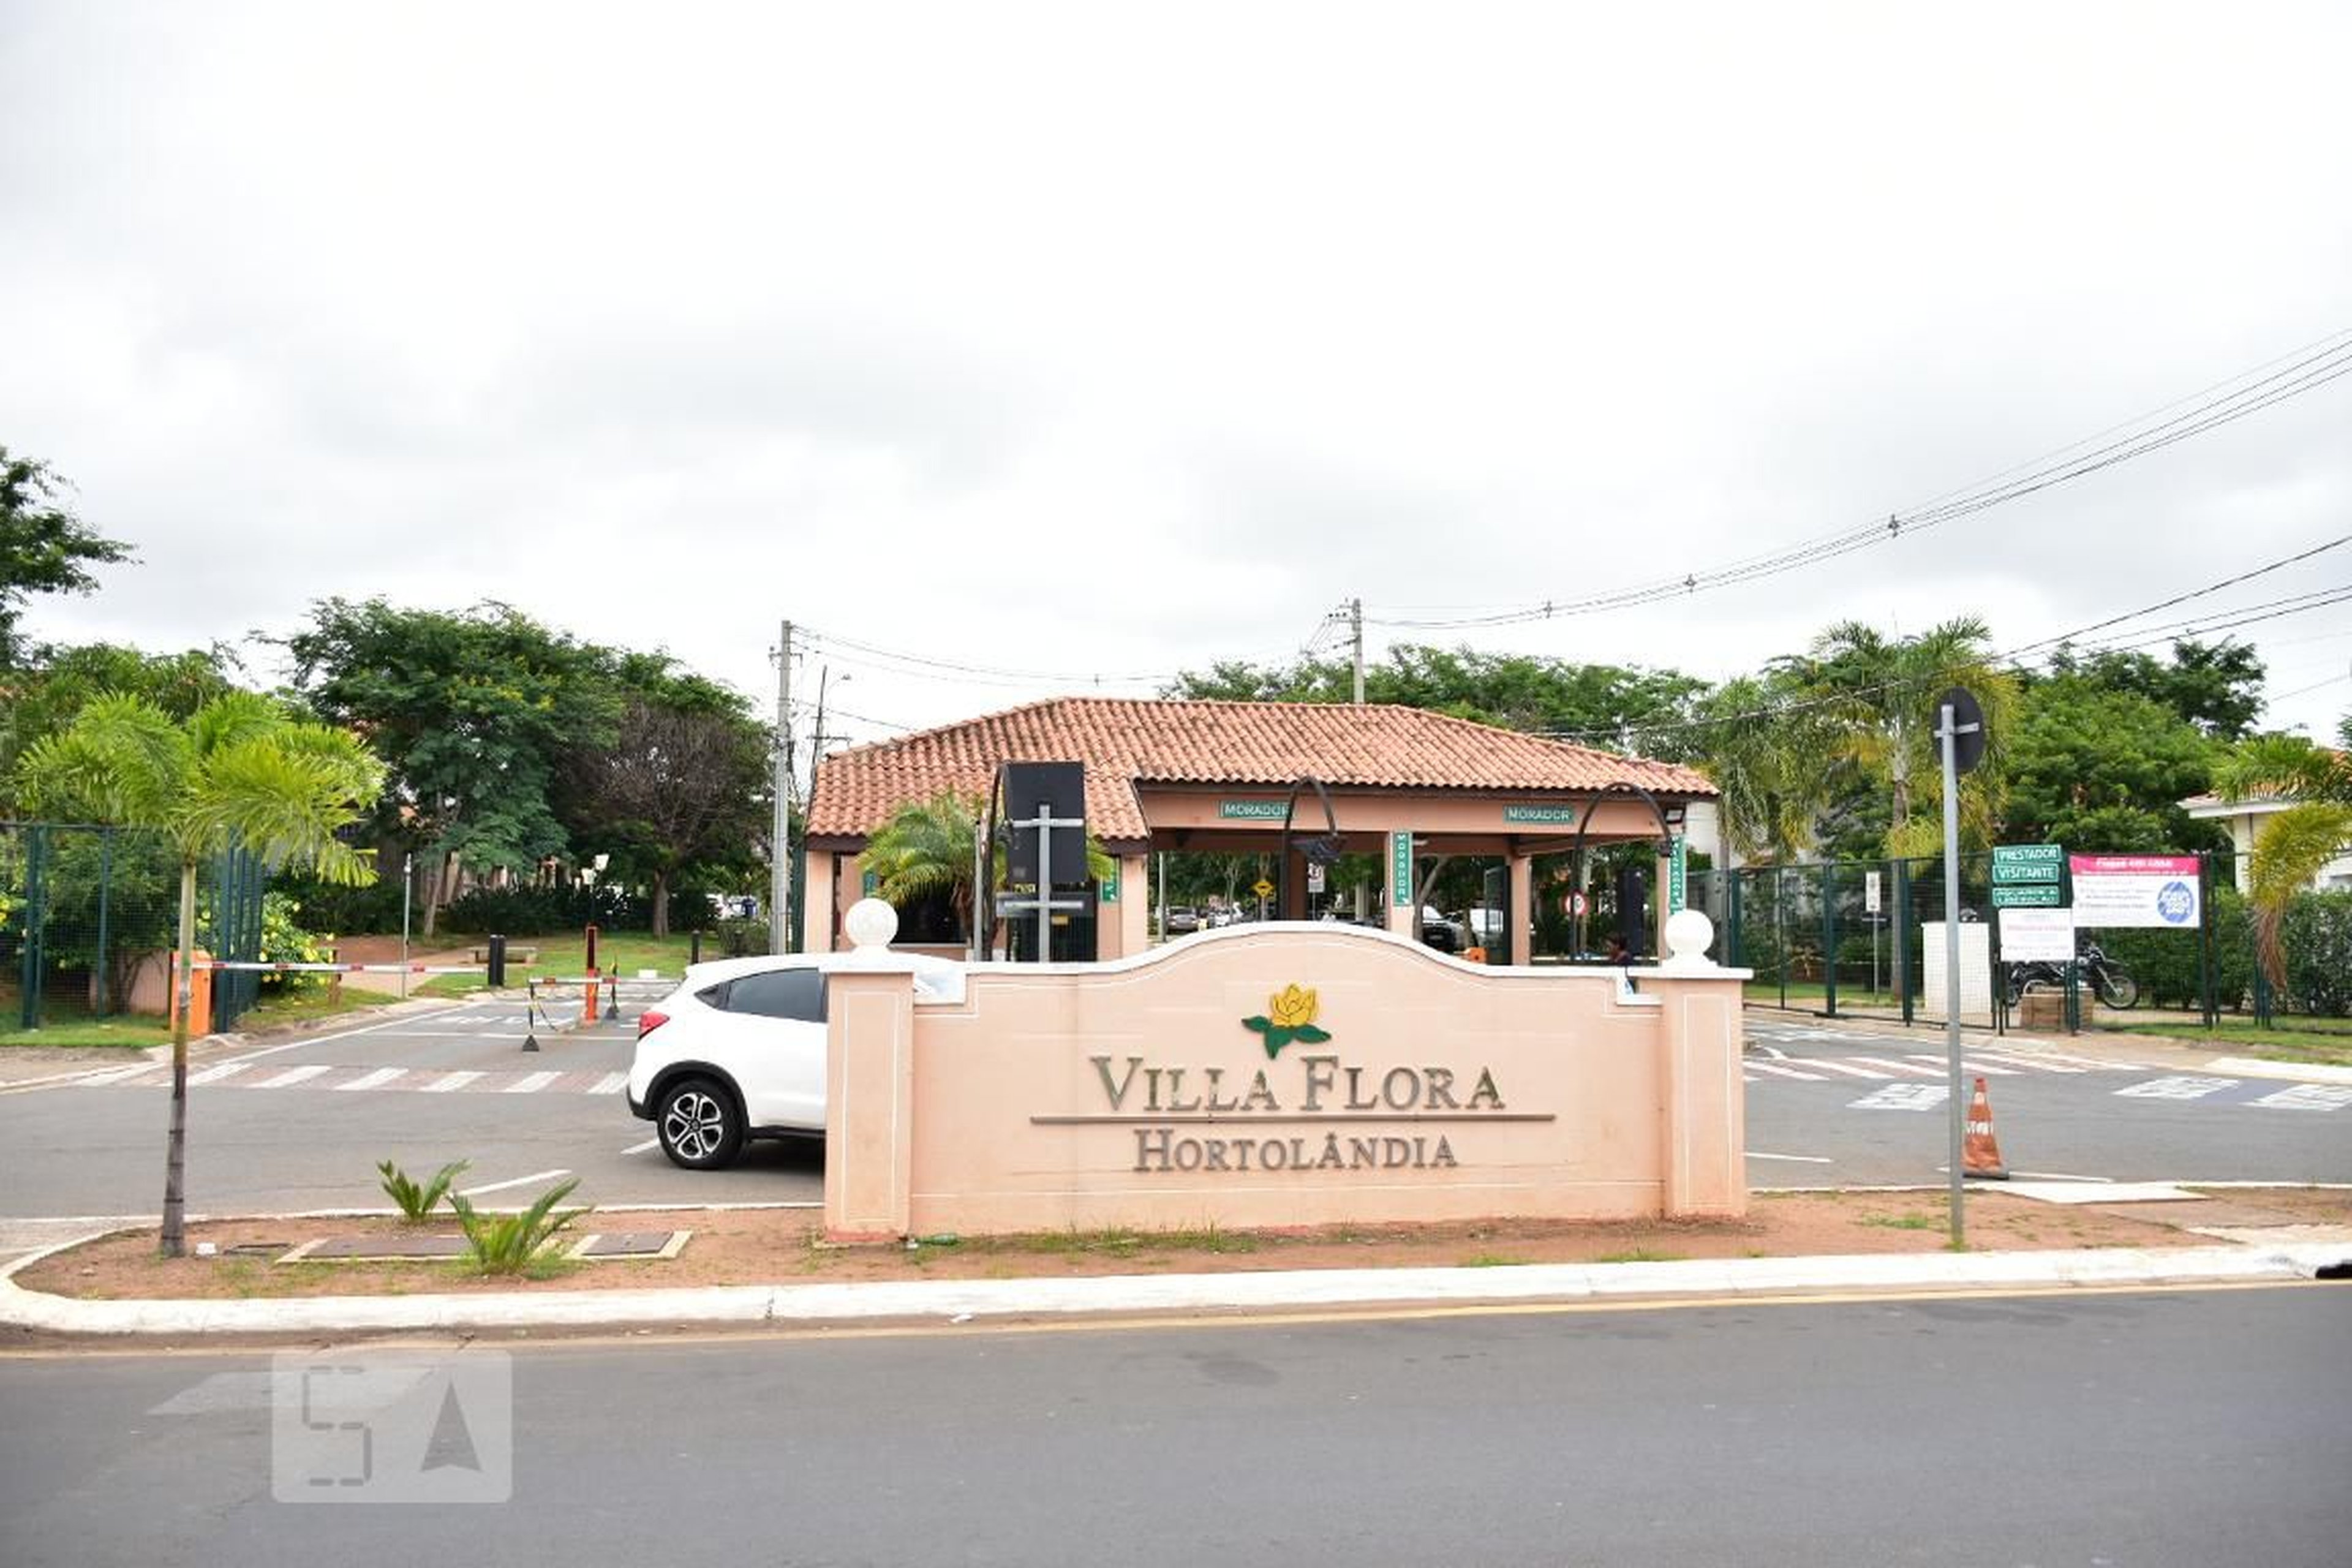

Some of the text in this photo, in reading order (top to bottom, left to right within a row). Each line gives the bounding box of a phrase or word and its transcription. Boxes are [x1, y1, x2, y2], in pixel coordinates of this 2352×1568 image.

[1508, 808, 1569, 820] MORADOR
[1999, 848, 2057, 860] PRESTADOR
[1998, 867, 2054, 879] VISITANTE
[1090, 1055, 1506, 1112] VILLA FLORA
[1133, 1128, 1458, 1172] HORTOLÂNDIA
